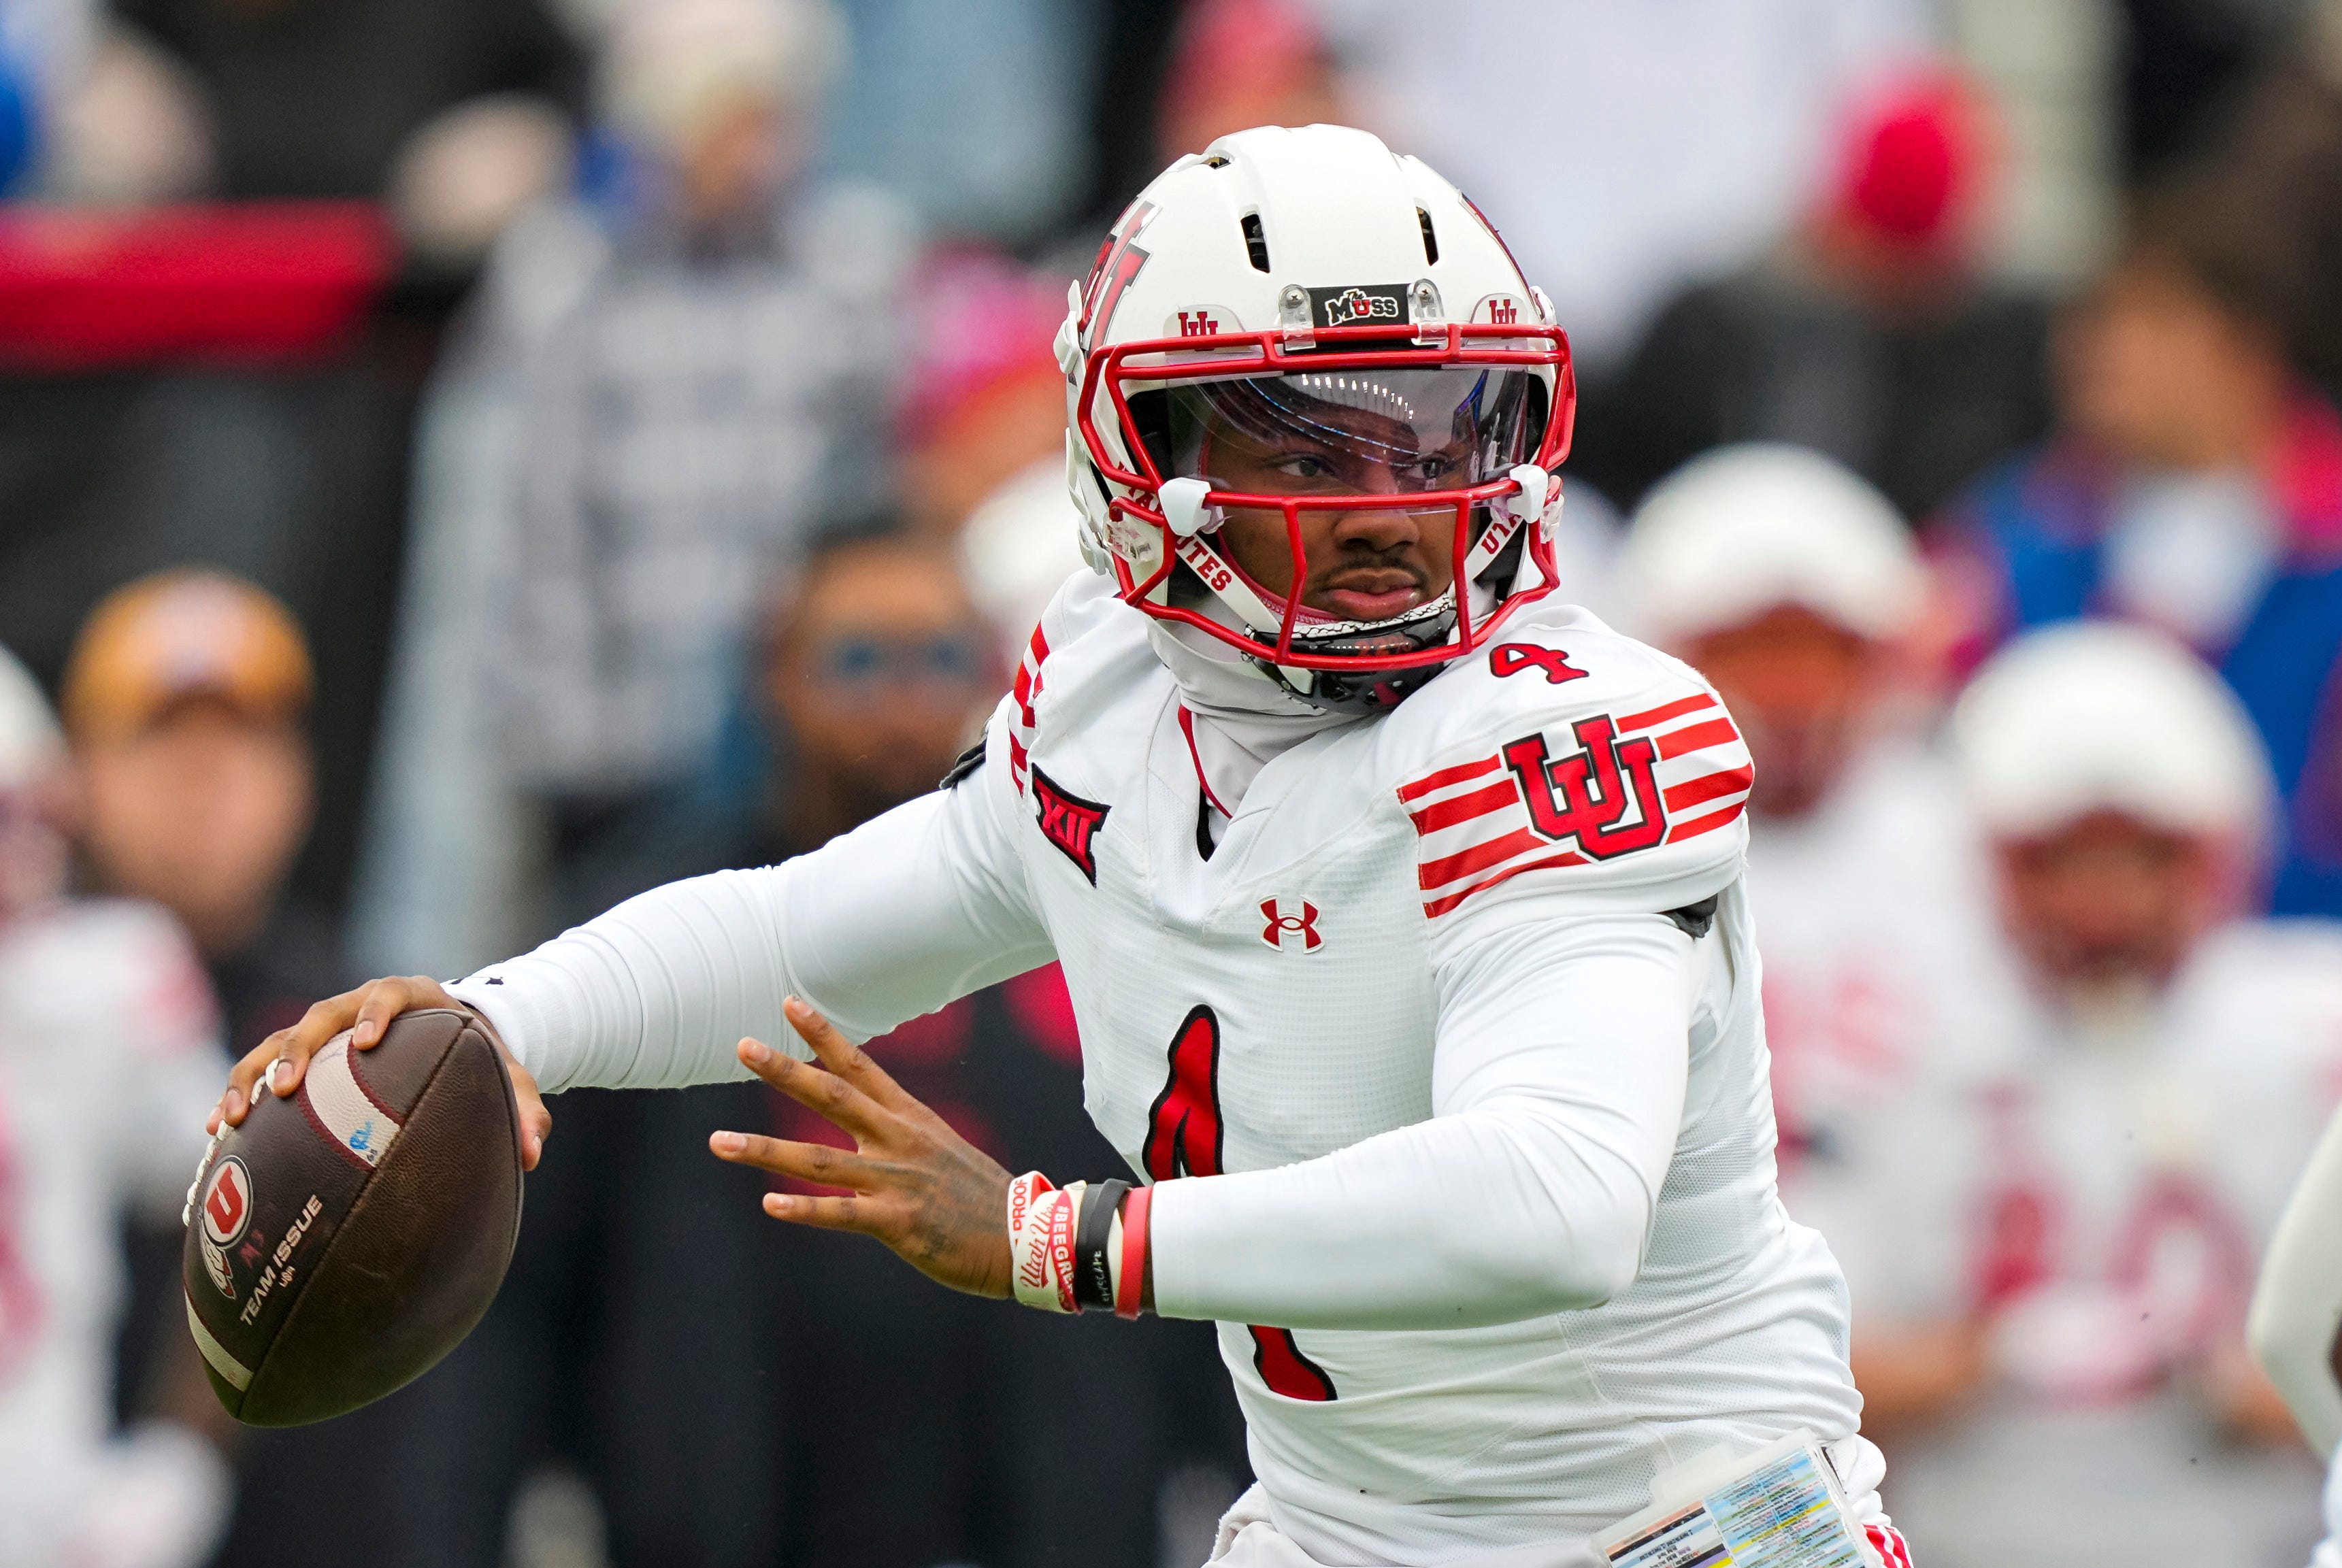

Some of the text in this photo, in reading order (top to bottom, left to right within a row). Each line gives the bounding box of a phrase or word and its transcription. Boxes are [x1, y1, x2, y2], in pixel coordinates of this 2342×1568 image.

[1325, 297, 1398, 326] MUSS
[1481, 514, 1521, 554] UTA
[1489, 643, 1589, 684] 4
[206, 1165, 243, 1234] U
[240, 1265, 276, 1326] TEAM
[273, 1194, 323, 1269] ISSUE
[1020, 1238, 1046, 1288] Utah
